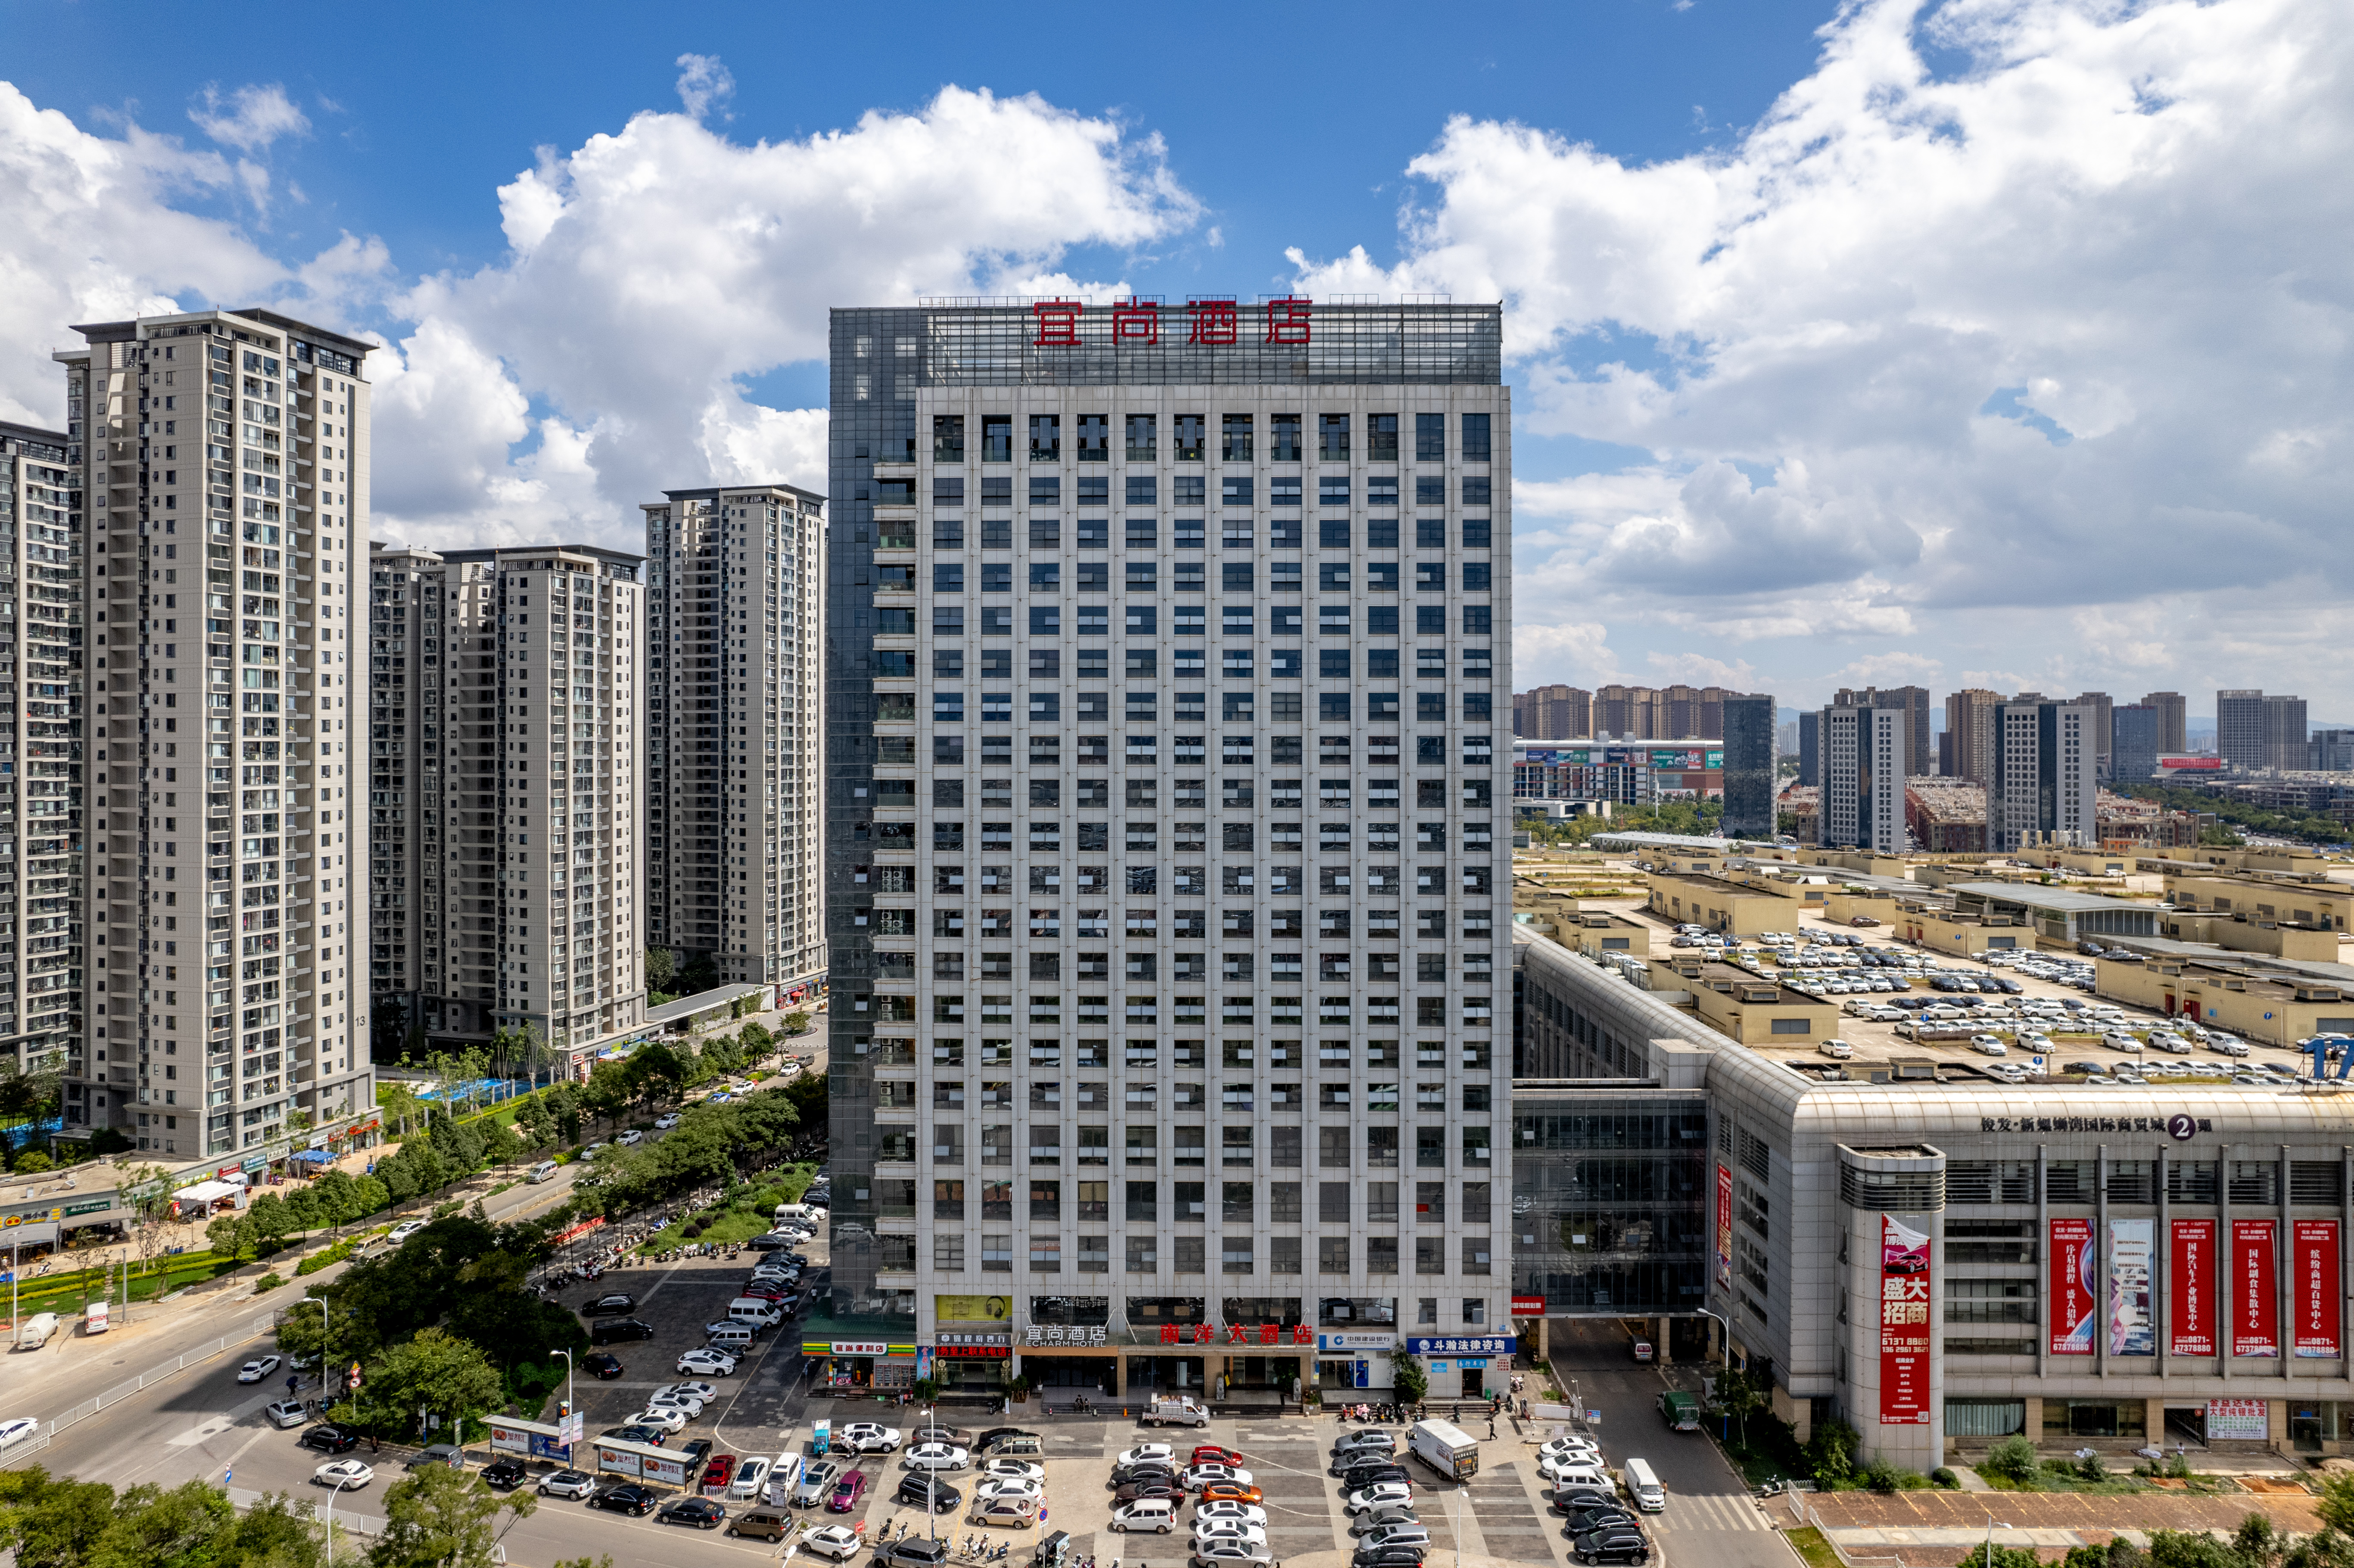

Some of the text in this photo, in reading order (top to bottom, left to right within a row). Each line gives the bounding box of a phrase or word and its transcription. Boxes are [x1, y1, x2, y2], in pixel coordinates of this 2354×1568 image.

[1034, 296, 1313, 345] 宜尚酒店
[635, 950, 641, 958] 12
[355, 1016, 365, 1027] 13
[2304, 1038, 2354, 1079] 17
[2066, 1244, 2076, 1283] 序启新程
[1883, 1277, 1928, 1300] 盛大
[2187, 1242, 2197, 1331] 国际汽车产业博览中心
[2248, 1249, 2259, 1328] 国际副食集散中心
[2310, 1249, 2321, 1329] 缤纷商超百货中心
[1883, 1301, 1928, 1325] 招商
[2067, 1289, 2076, 1328] 盛大招商
[954, 1335, 1005, 1343] 锦程寄售行
[1026, 1324, 1105, 1341] 宜尚酒店
[1160, 1323, 1312, 1344] 南洋大酒店
[1434, 1340, 1505, 1350] 斗瀚法律咨询
[2210, 1399, 2265, 1407] 金益达珠宝
[2210, 1407, 2265, 1416] 大型纯银批发
[508, 1432, 527, 1443] 蟹都汇
[617, 1454, 638, 1465] 蟹都汇
[660, 1463, 682, 1475] 蟹都汇
